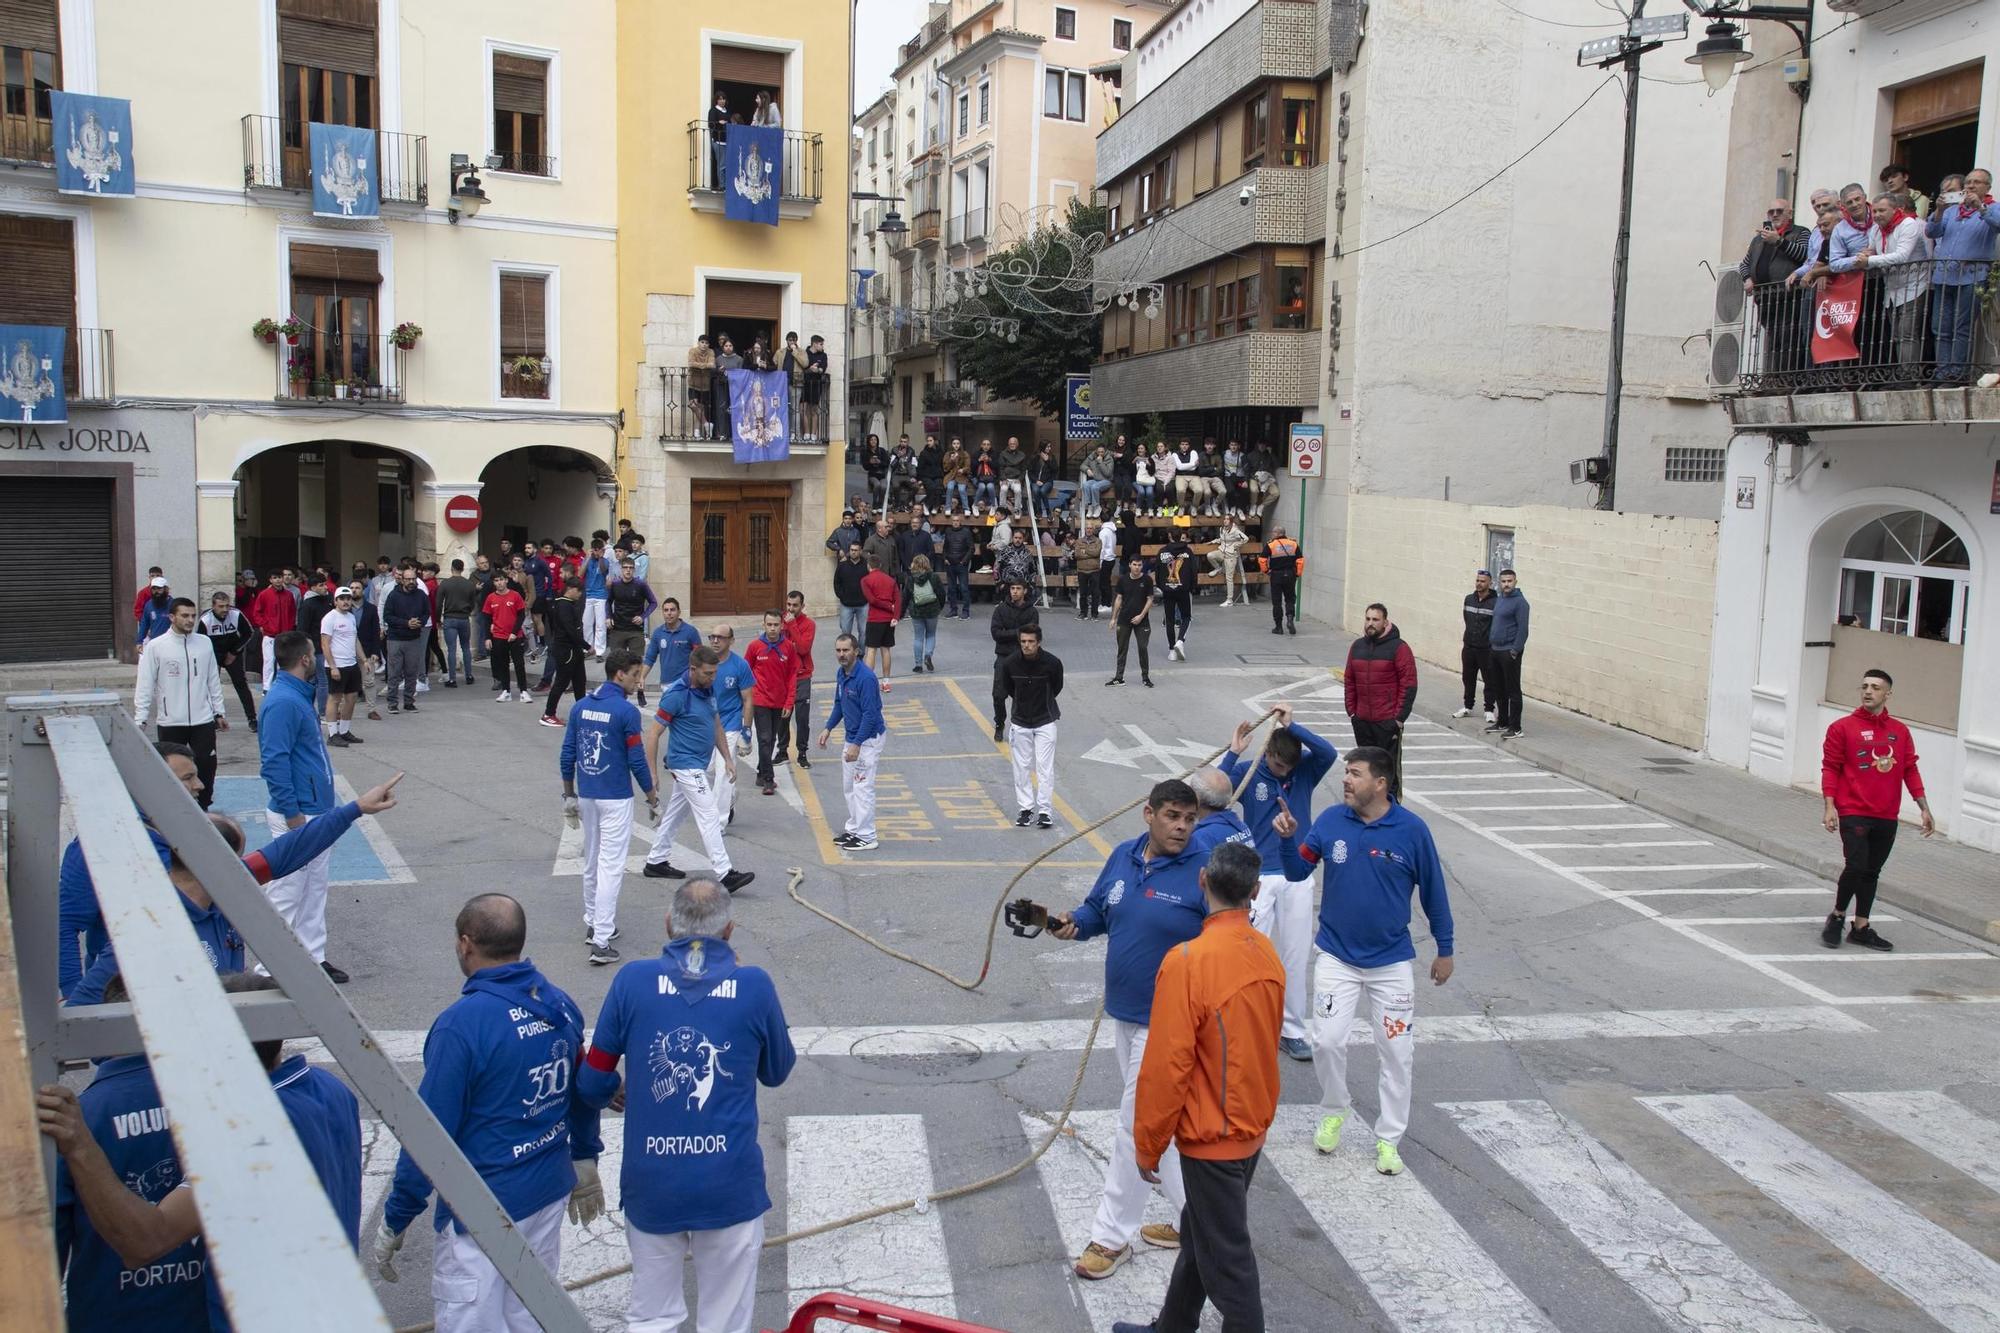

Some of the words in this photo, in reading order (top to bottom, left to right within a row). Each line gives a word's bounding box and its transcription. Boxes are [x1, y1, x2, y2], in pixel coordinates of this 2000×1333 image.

[1830, 303, 1847, 314] BOU
[58, 428, 152, 453] JORDA
[212, 624, 236, 634] FILA
[658, 975, 737, 998] VOARI
[522, 1057, 570, 1105] 350
[646, 1134, 727, 1155] PORTADOR
